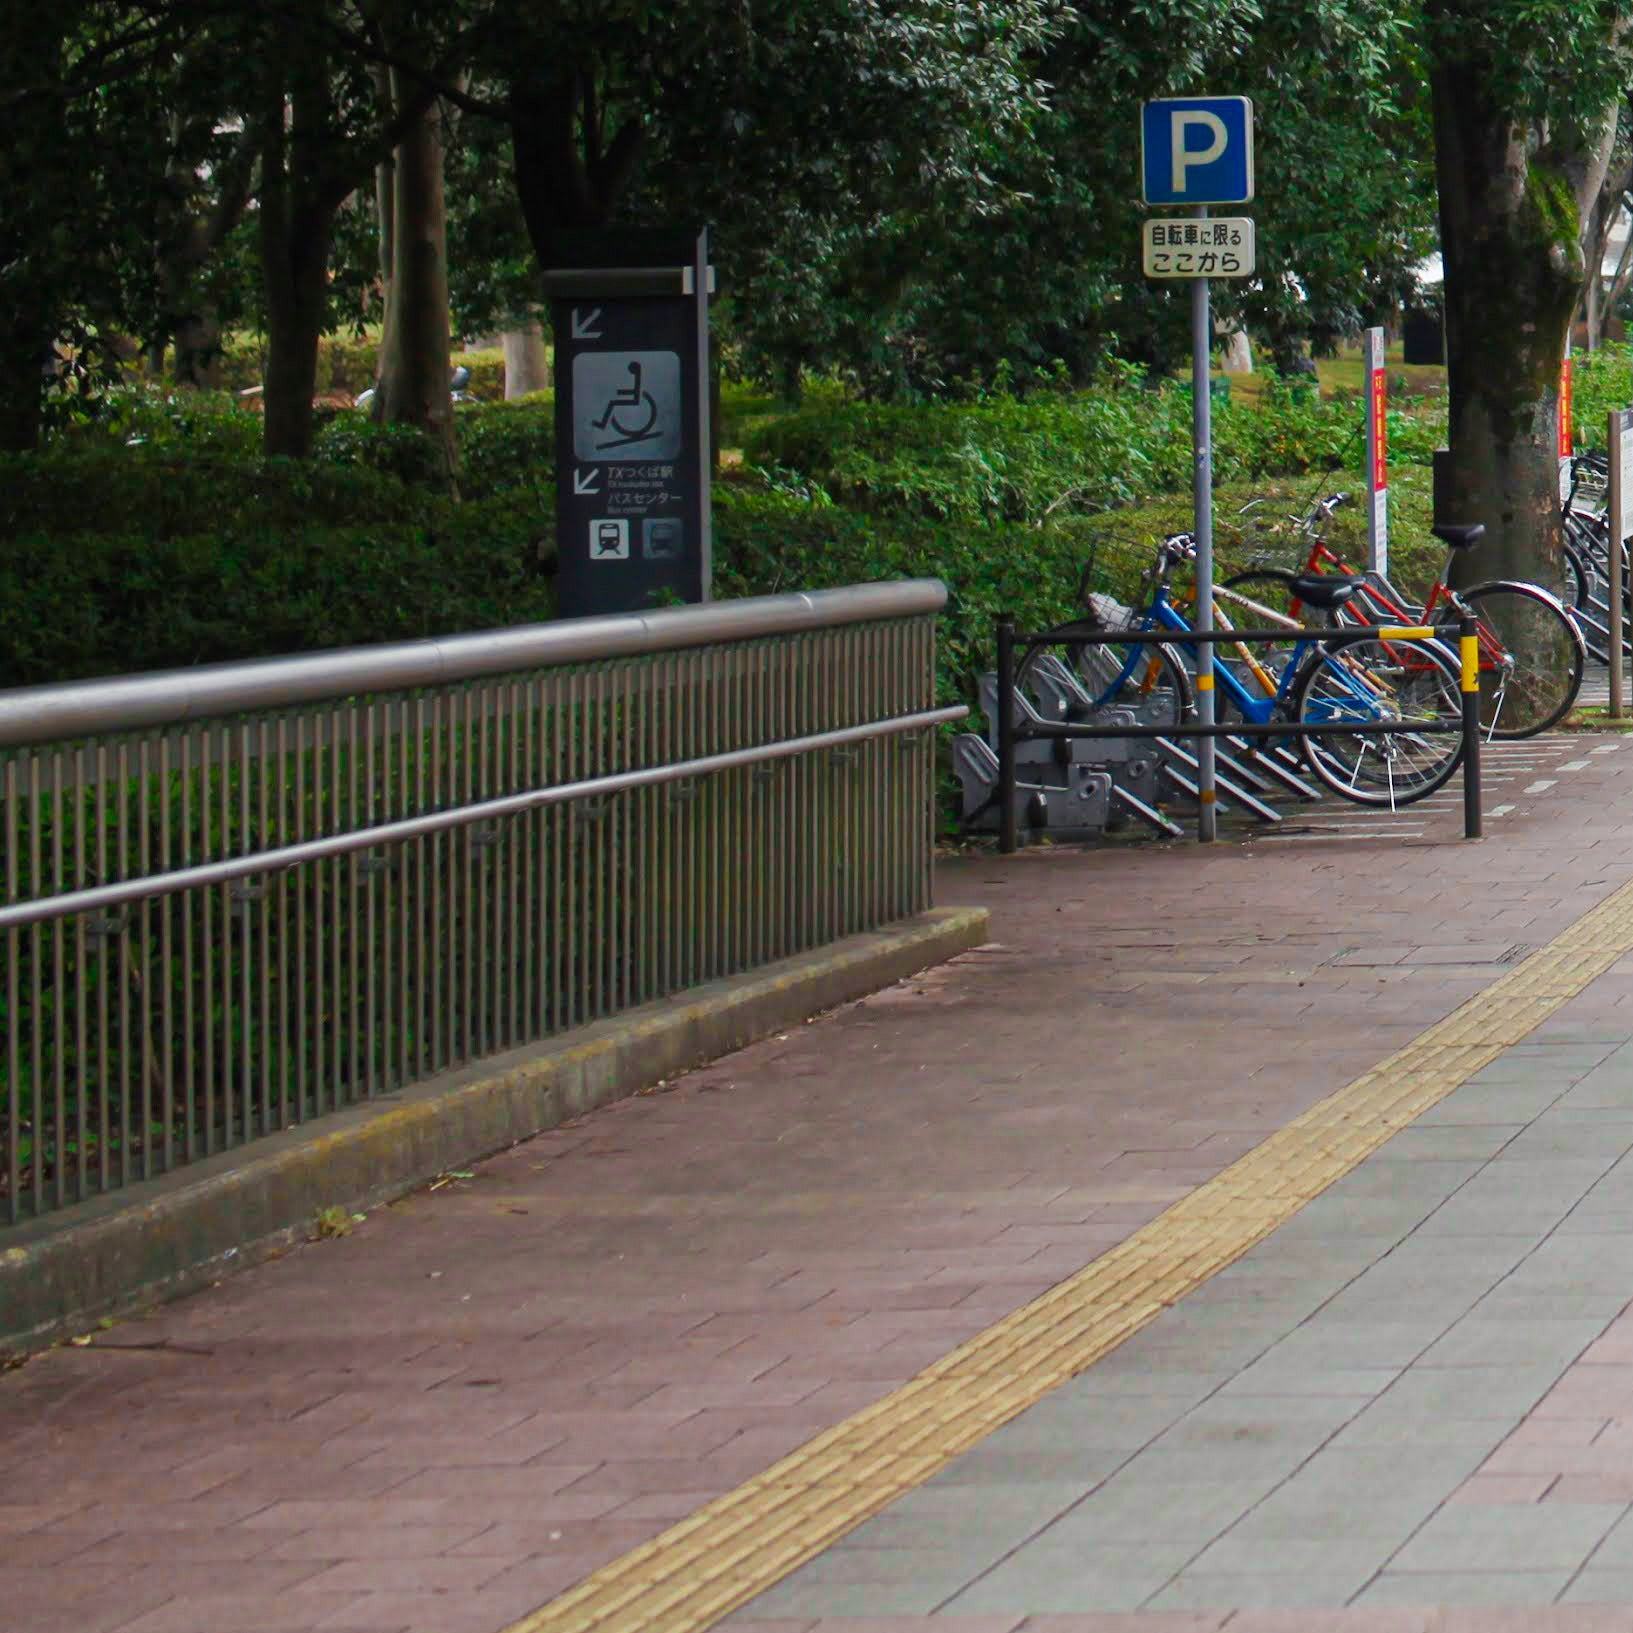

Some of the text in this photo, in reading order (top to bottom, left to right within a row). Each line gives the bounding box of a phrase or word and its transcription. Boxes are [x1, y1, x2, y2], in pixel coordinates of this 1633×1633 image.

[1170, 110, 1229, 193] P
[1152, 224, 1242, 246] 自転車に限る
[1153, 252, 1241, 273] ここから
